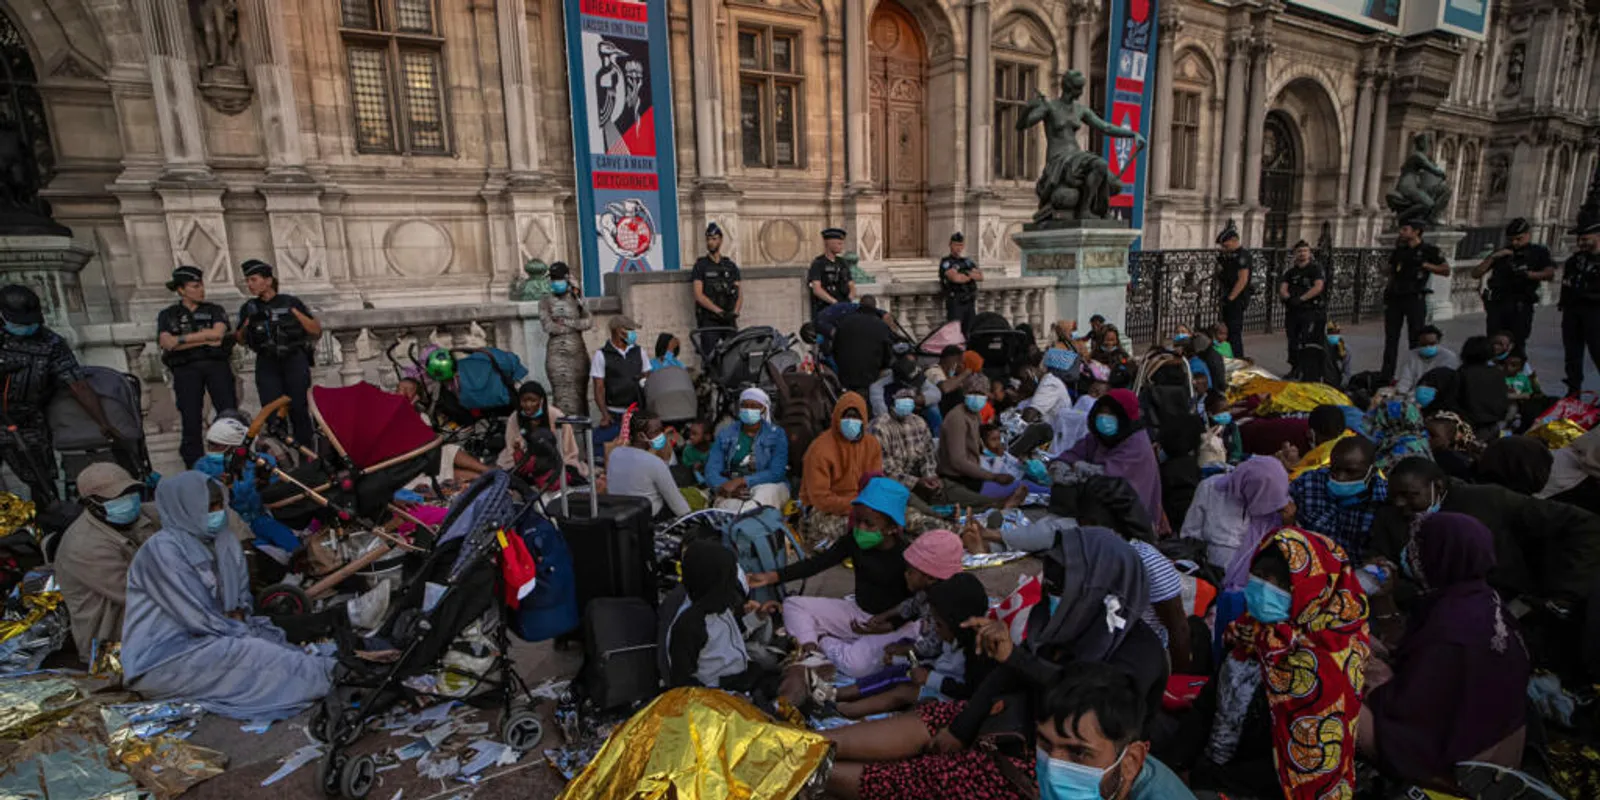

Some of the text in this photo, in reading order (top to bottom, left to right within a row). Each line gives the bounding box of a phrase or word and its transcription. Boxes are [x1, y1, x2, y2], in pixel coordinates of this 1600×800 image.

[585, 0, 641, 18] BREAK OUT
[596, 156, 653, 170] CARVE A MARK
